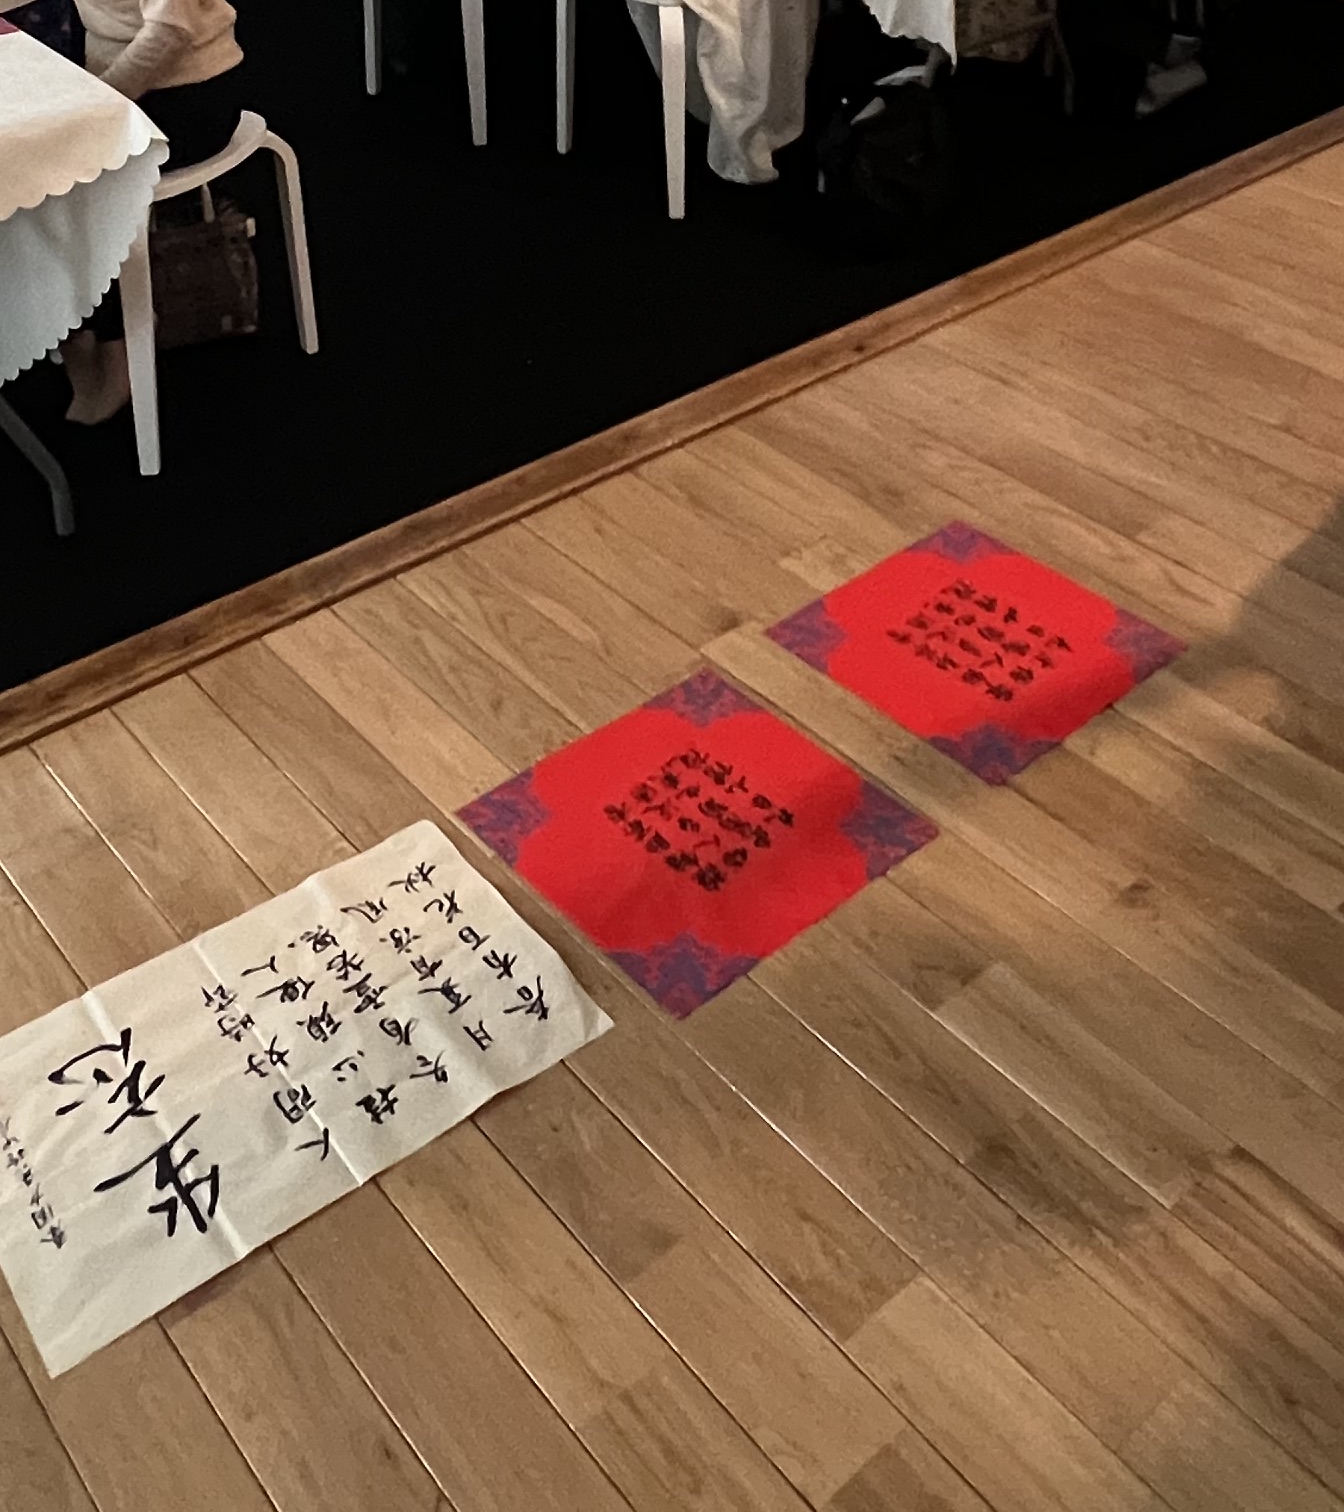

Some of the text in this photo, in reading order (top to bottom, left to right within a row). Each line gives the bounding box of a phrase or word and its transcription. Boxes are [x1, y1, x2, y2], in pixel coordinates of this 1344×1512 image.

[388, 861, 550, 1021] 春有百花秋
[47, 1027, 219, 1237] 坐忘
